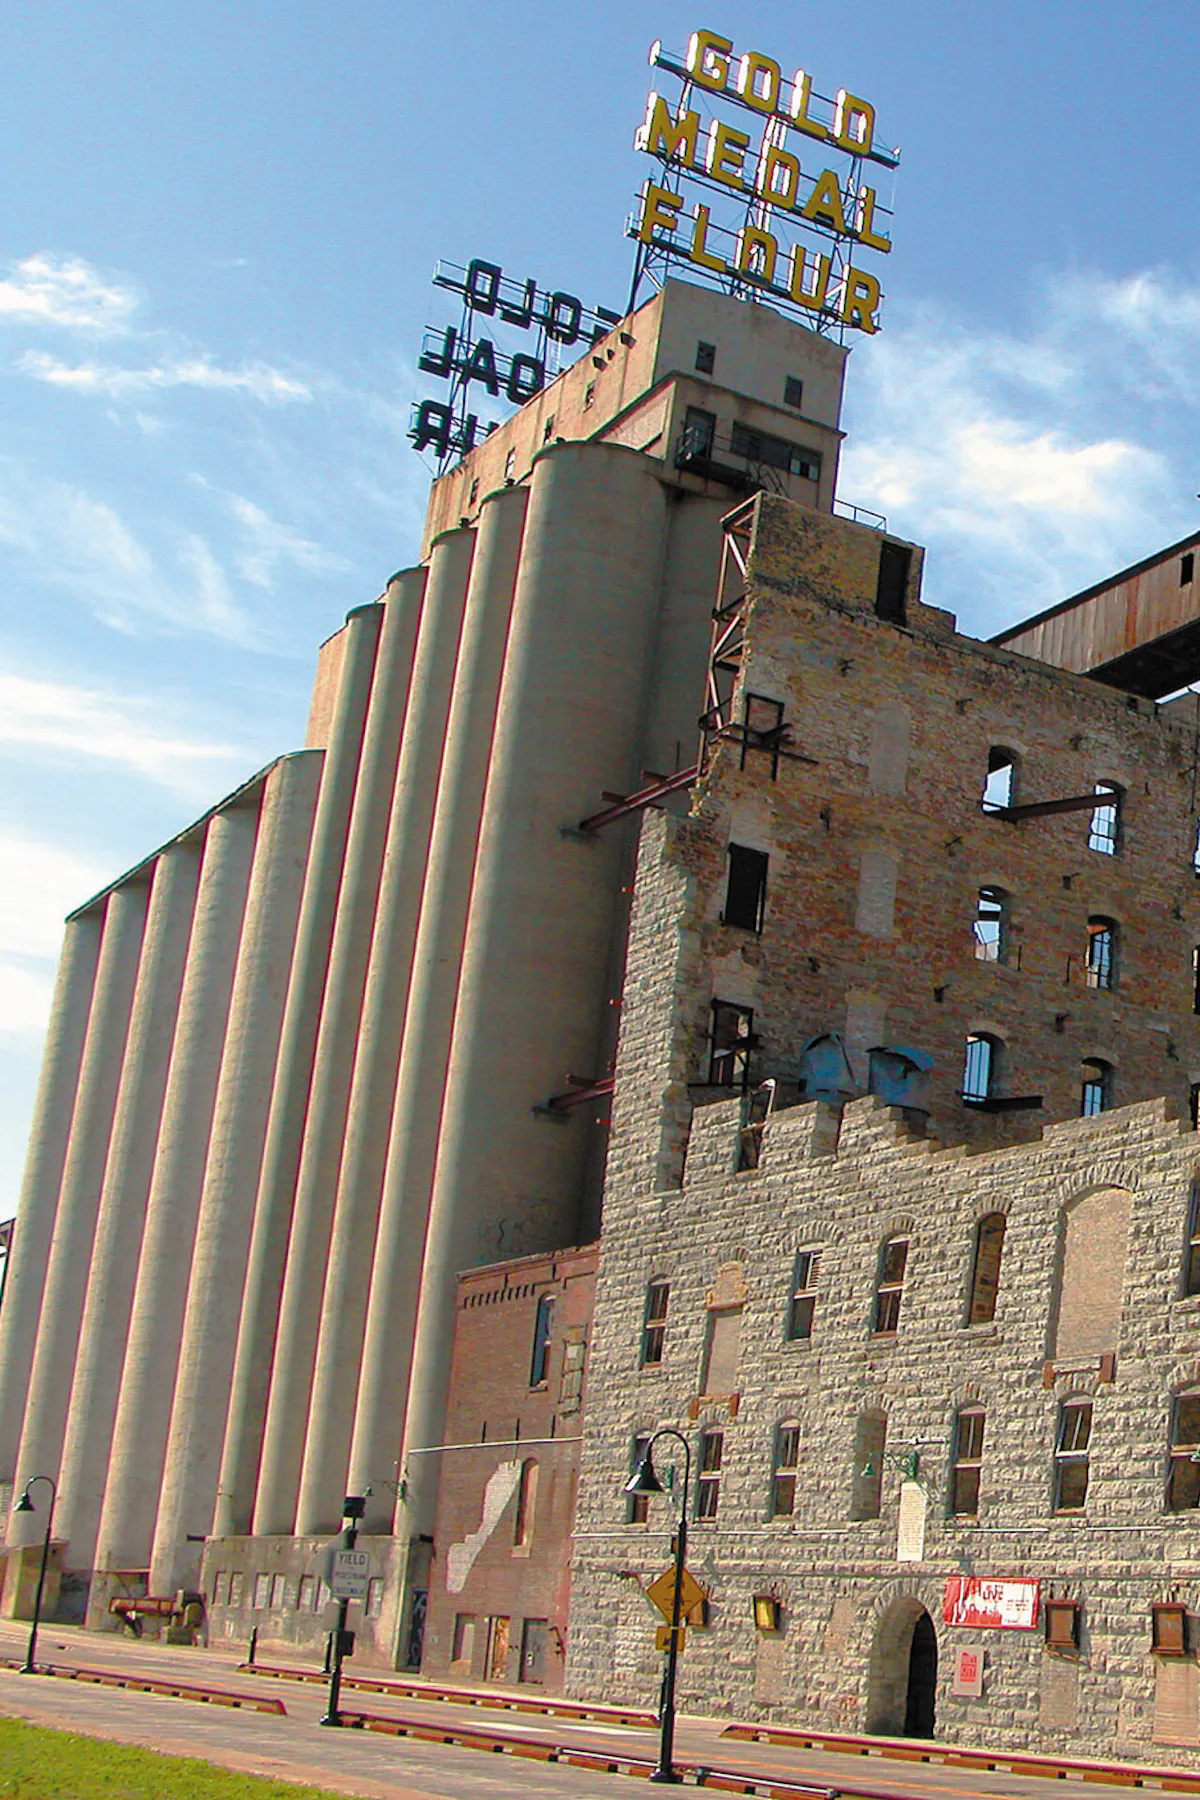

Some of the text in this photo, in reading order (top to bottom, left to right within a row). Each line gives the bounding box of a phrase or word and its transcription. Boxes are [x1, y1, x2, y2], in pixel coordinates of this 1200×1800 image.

[686, 28, 876, 155] GOLD
[645, 90, 892, 254] MEDAL
[640, 178, 881, 335] FLOUR
[340, 1554, 366, 1565] YIELD
